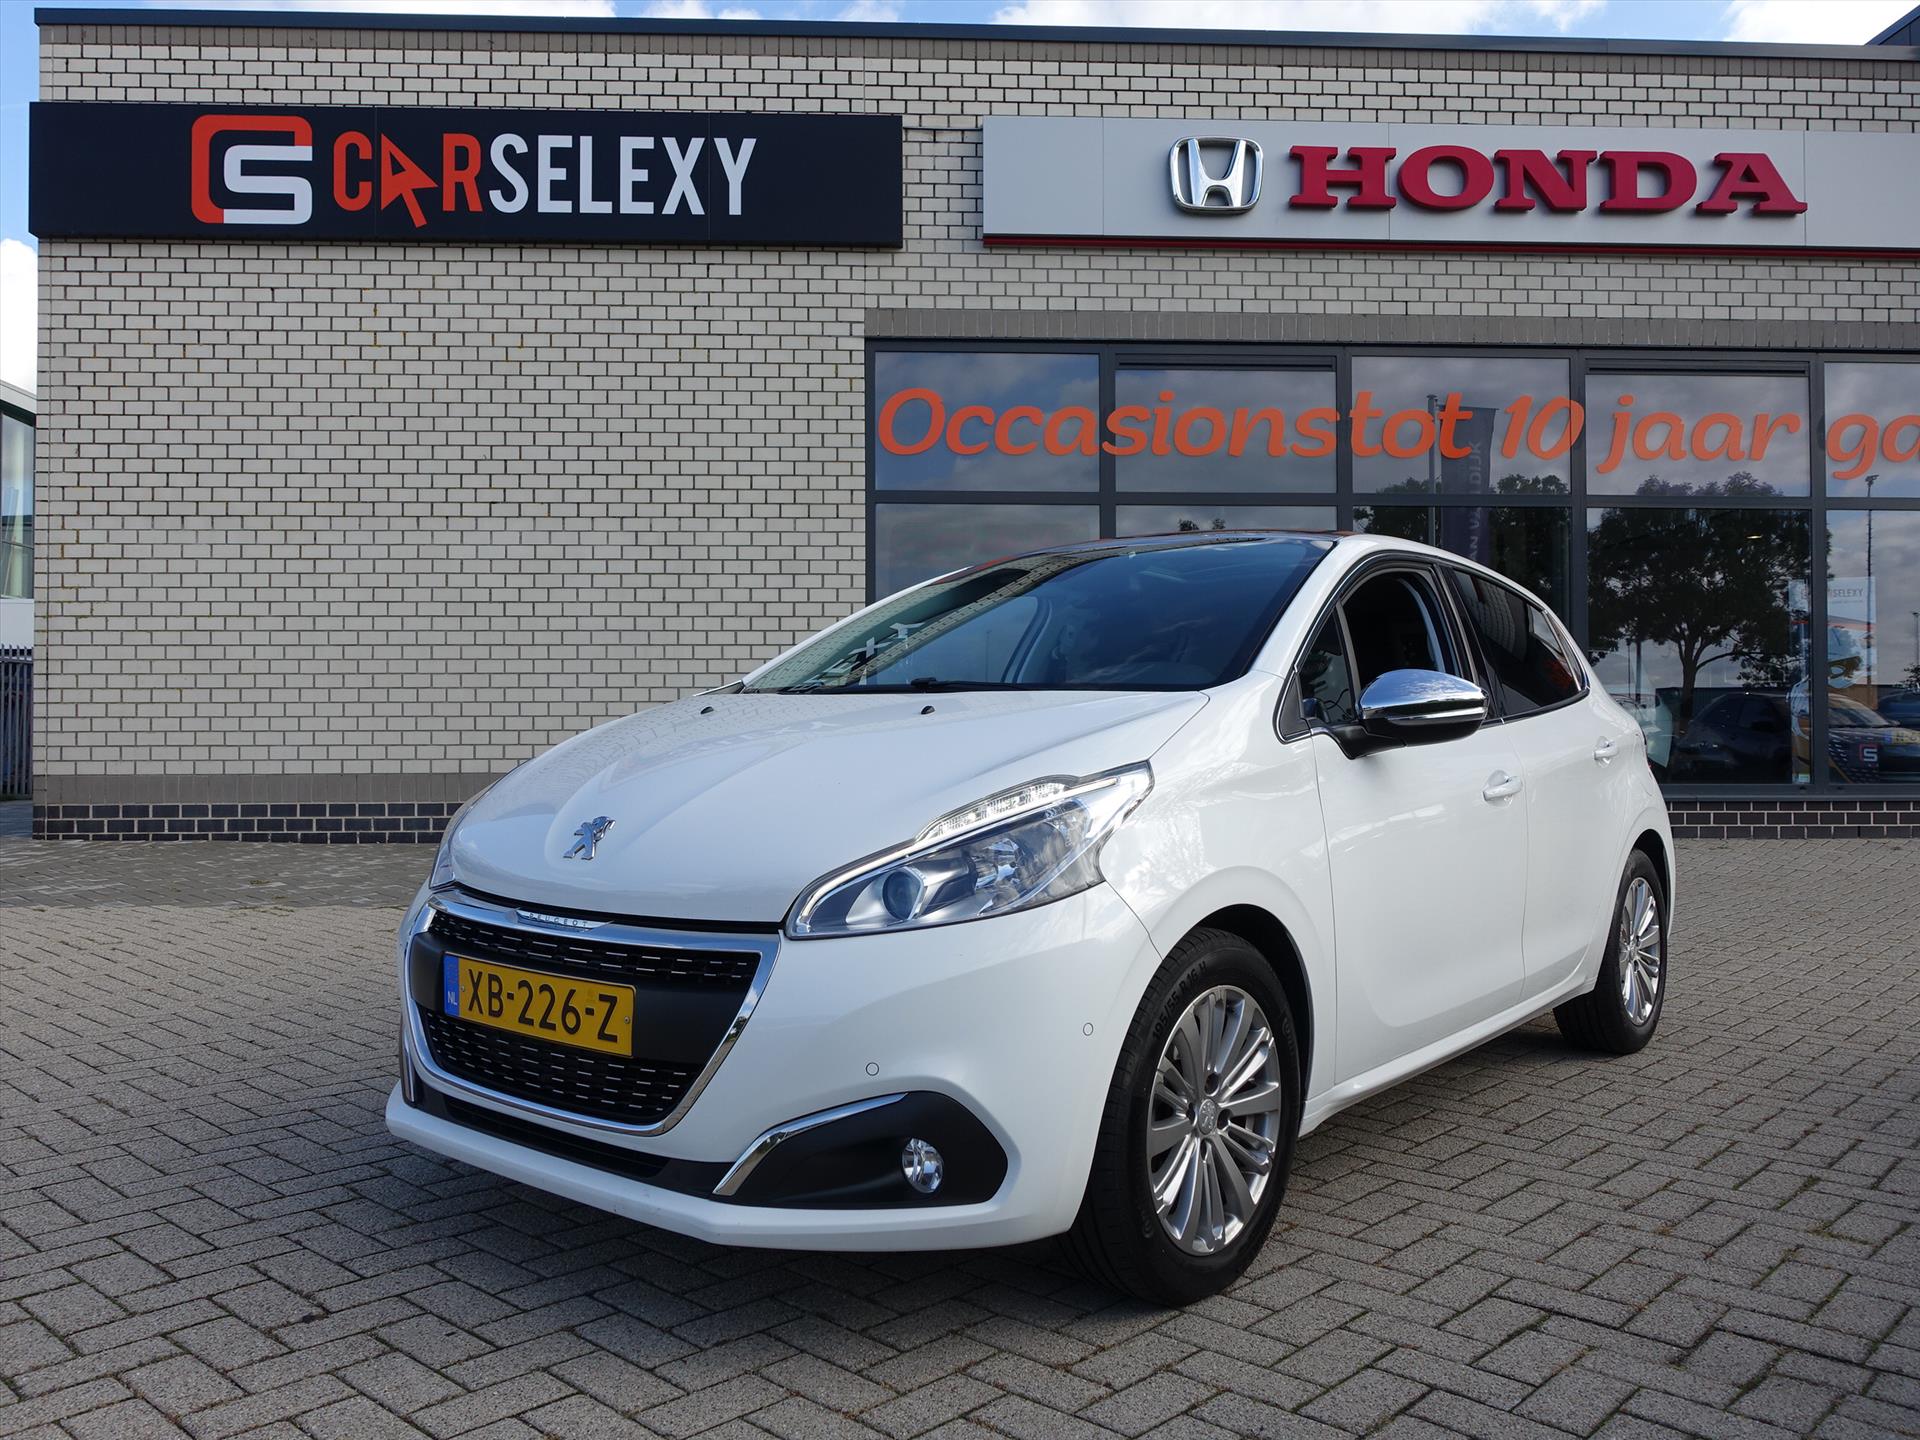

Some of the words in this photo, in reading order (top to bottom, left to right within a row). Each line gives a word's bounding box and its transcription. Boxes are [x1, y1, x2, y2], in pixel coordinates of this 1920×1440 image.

[332, 130, 757, 228] CARSELEXY
[1289, 144, 1808, 213] HONDA
[877, 387, 1341, 457] Occasions
[1349, 390, 1474, 460] tot
[1500, 395, 1586, 460] 10
[1596, 394, 1802, 474] jaar
[1469, 440, 1482, 484] DIJK
[1830, 587, 1864, 598] SELEXY
[529, 912, 587, 927] PEUGEOT
[447, 990, 459, 1007] NL
[467, 967, 619, 1044] XB-226-Z
